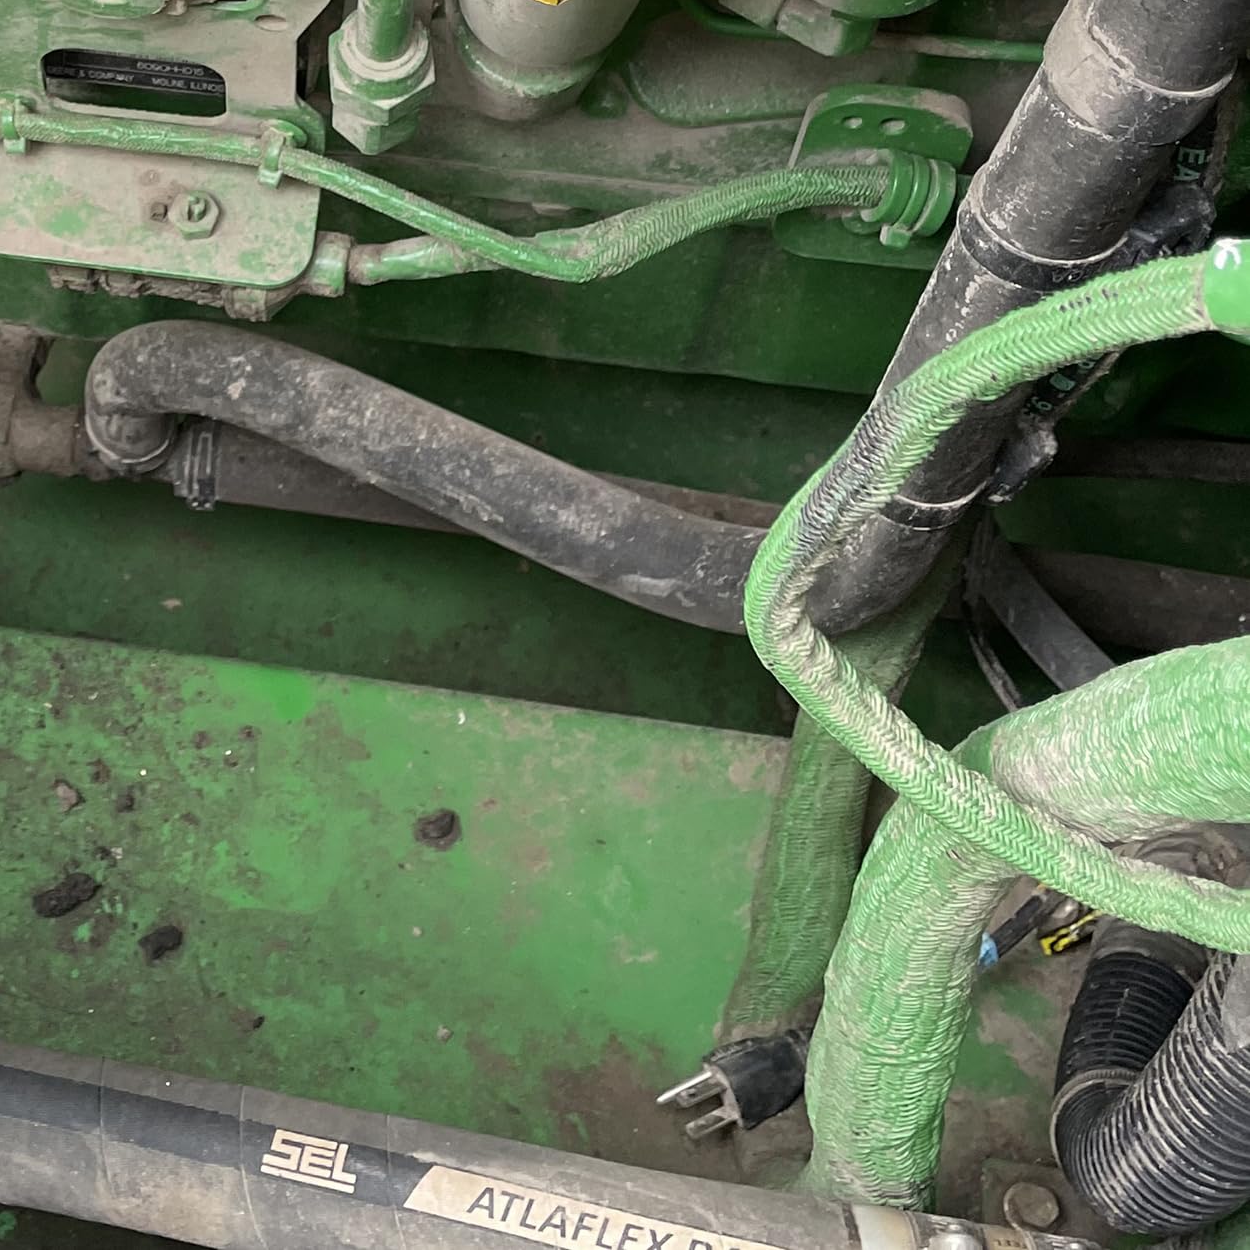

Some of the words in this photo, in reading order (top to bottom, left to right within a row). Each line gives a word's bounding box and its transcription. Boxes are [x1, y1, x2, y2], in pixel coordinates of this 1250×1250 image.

[88, 70, 134, 82] COMPANY
[261, 1128, 357, 1190] SEL
[466, 1186, 673, 1250] ATLAFLEX
